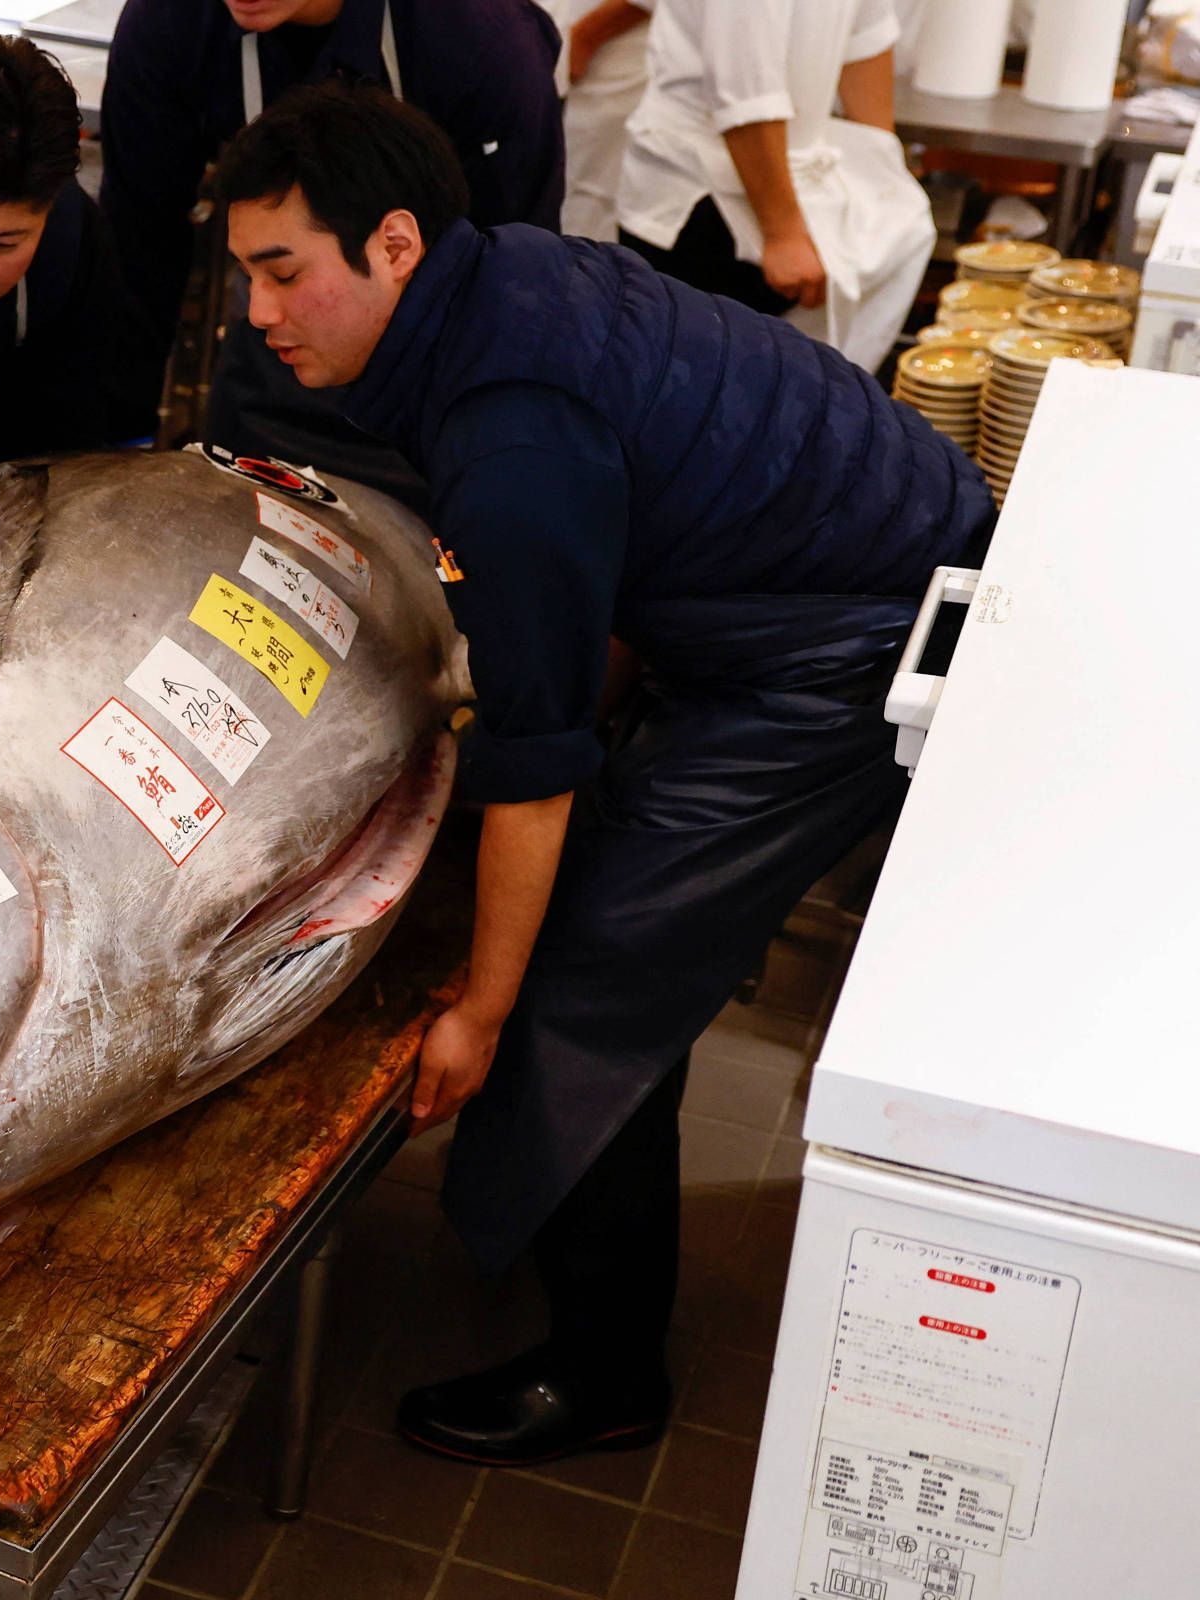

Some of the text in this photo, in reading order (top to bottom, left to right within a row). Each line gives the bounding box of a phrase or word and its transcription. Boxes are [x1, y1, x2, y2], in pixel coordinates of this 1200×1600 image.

[222, 607, 294, 671] 大間
[104, 736, 176, 808] 一番鮪
